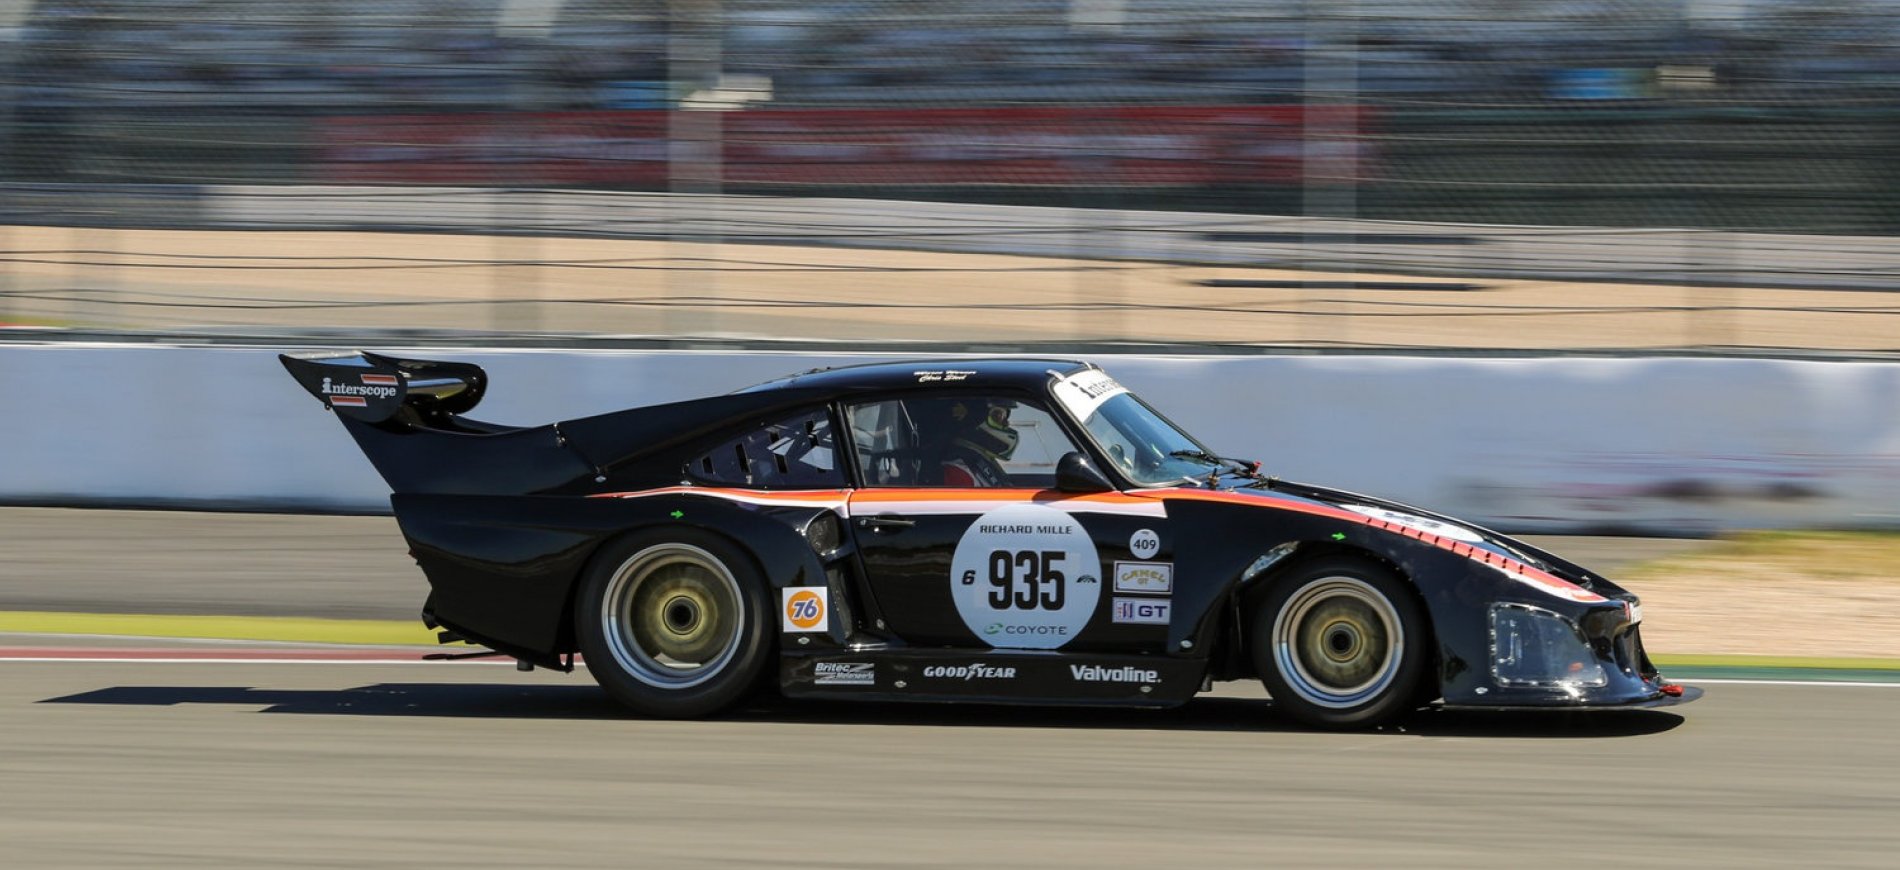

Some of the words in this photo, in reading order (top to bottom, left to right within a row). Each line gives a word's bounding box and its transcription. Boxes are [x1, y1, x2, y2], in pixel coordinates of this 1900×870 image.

[322, 377, 396, 398] interscope
[979, 525, 1033, 535] RICHARD
[1036, 525, 1073, 535] MILLE
[1133, 540, 1157, 550] 409
[962, 570, 976, 586] 6
[989, 550, 1066, 611] 935
[1121, 569, 1166, 583] CAMEL
[792, 597, 819, 620] 76
[1138, 605, 1168, 618] GT
[1005, 625, 1068, 636] COYOTE
[816, 663, 851, 672] Britec
[923, 663, 1016, 681] GOODYEAR
